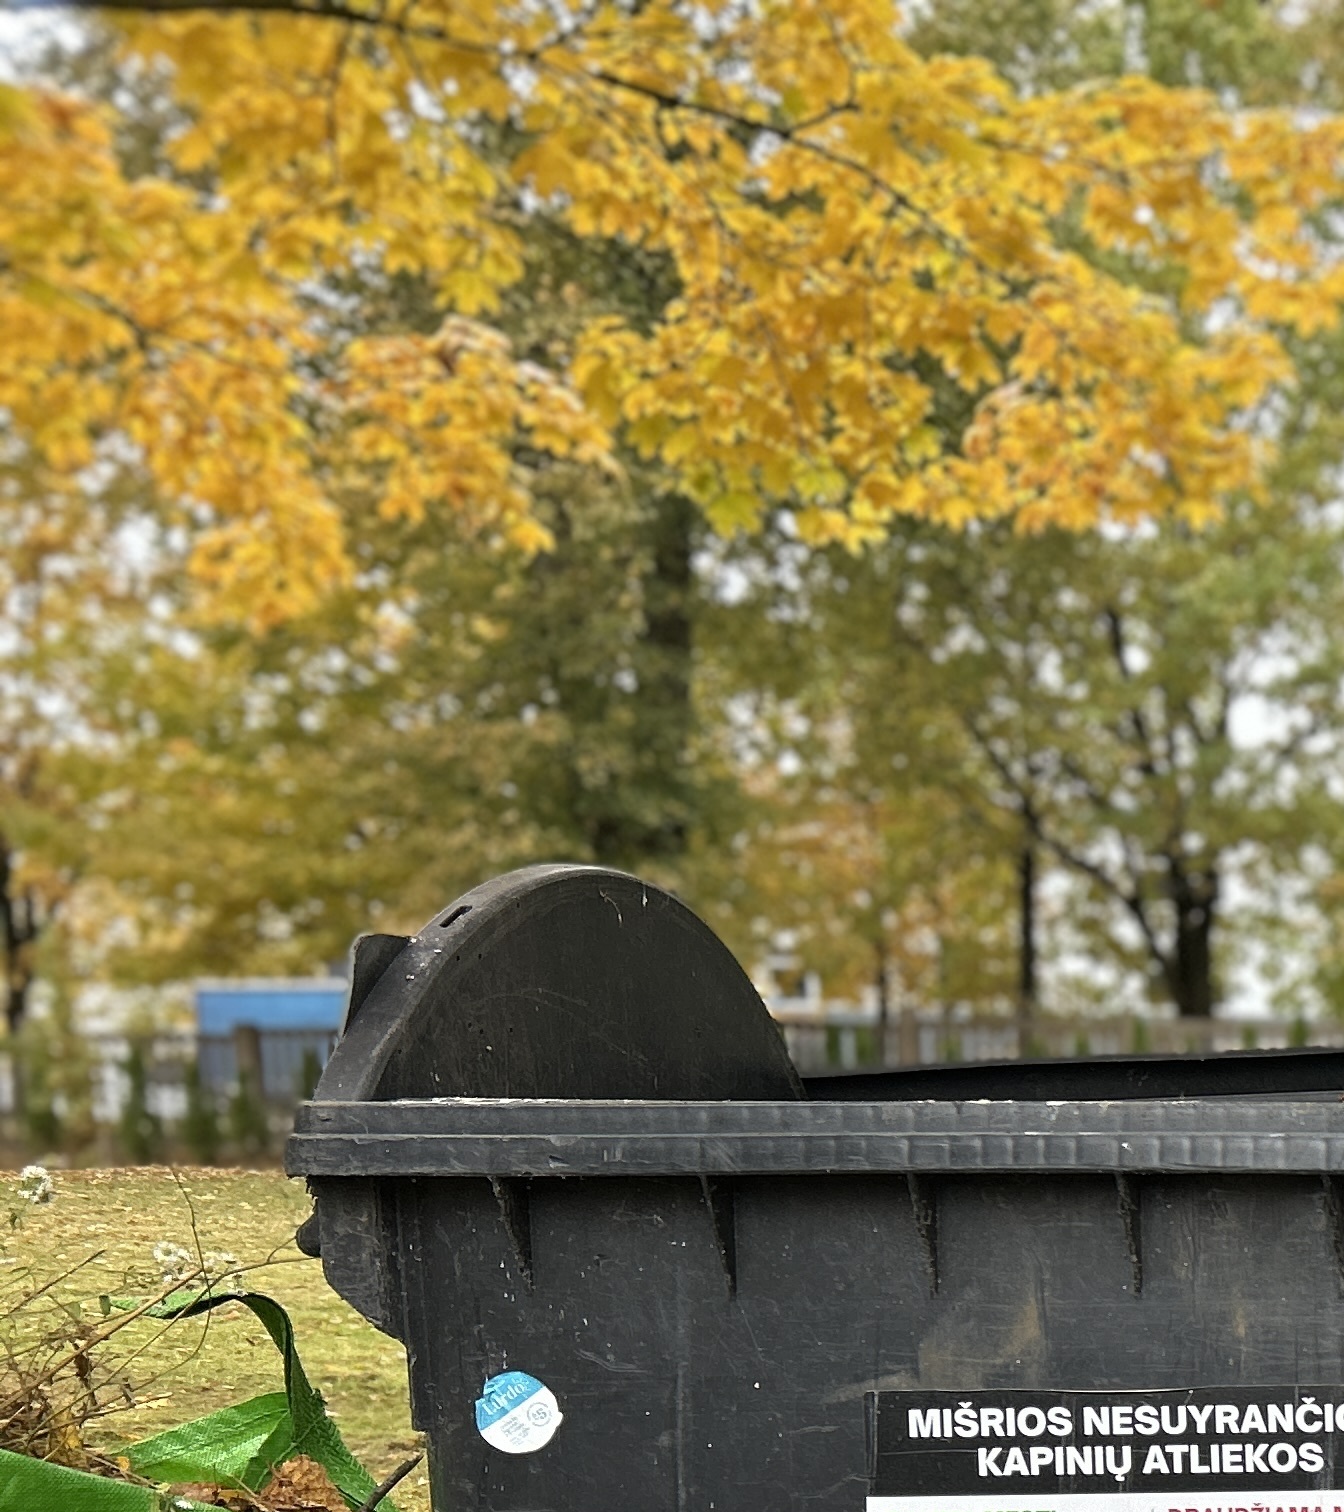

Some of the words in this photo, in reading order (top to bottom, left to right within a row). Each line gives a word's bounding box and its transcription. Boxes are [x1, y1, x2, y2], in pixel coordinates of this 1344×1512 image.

[908, 1402, 1072, 1438] MIŠRIOS
[978, 1447, 1132, 1482] KAPINIŲ
[1144, 1443, 1323, 1474] ATLIEKOS
